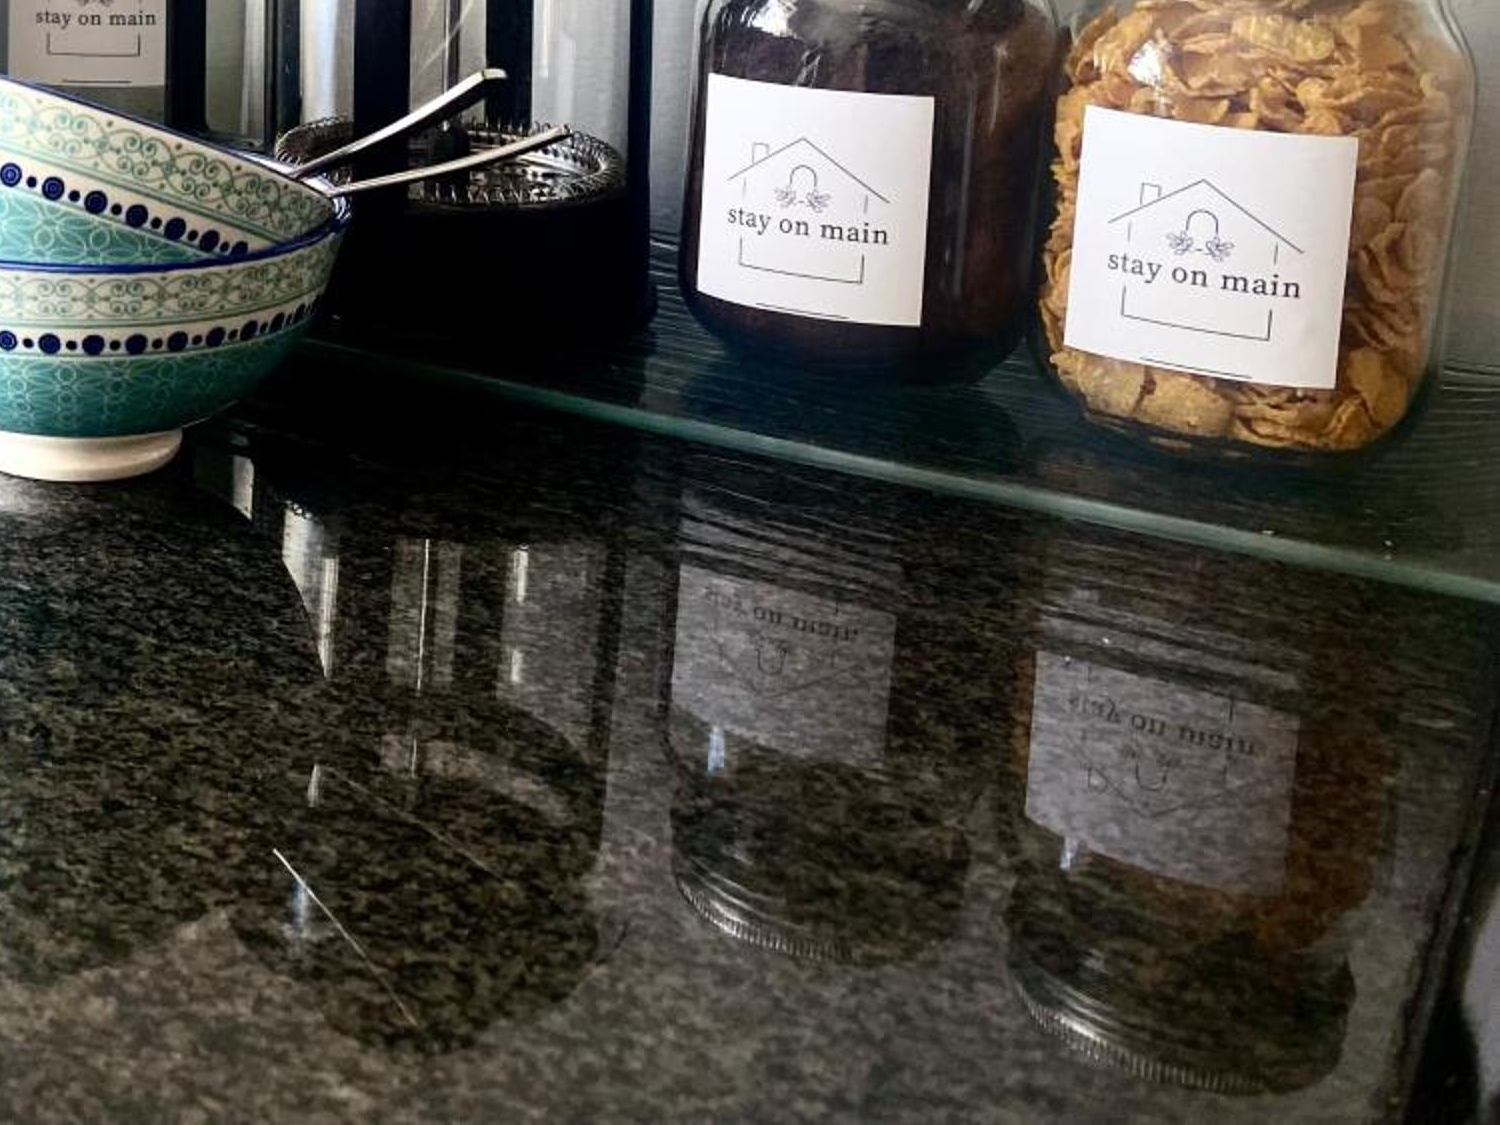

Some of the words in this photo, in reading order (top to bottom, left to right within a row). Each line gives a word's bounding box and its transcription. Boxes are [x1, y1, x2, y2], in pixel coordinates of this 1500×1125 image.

[36, 9, 71, 30] stay
[78, 12, 101, 26] on
[109, 11, 157, 27] main
[727, 207, 772, 236] stay
[779, 217, 810, 236] on
[820, 221, 889, 245] main
[1107, 251, 1163, 283] stay
[1172, 265, 1207, 287] on
[1220, 271, 1301, 299] main
